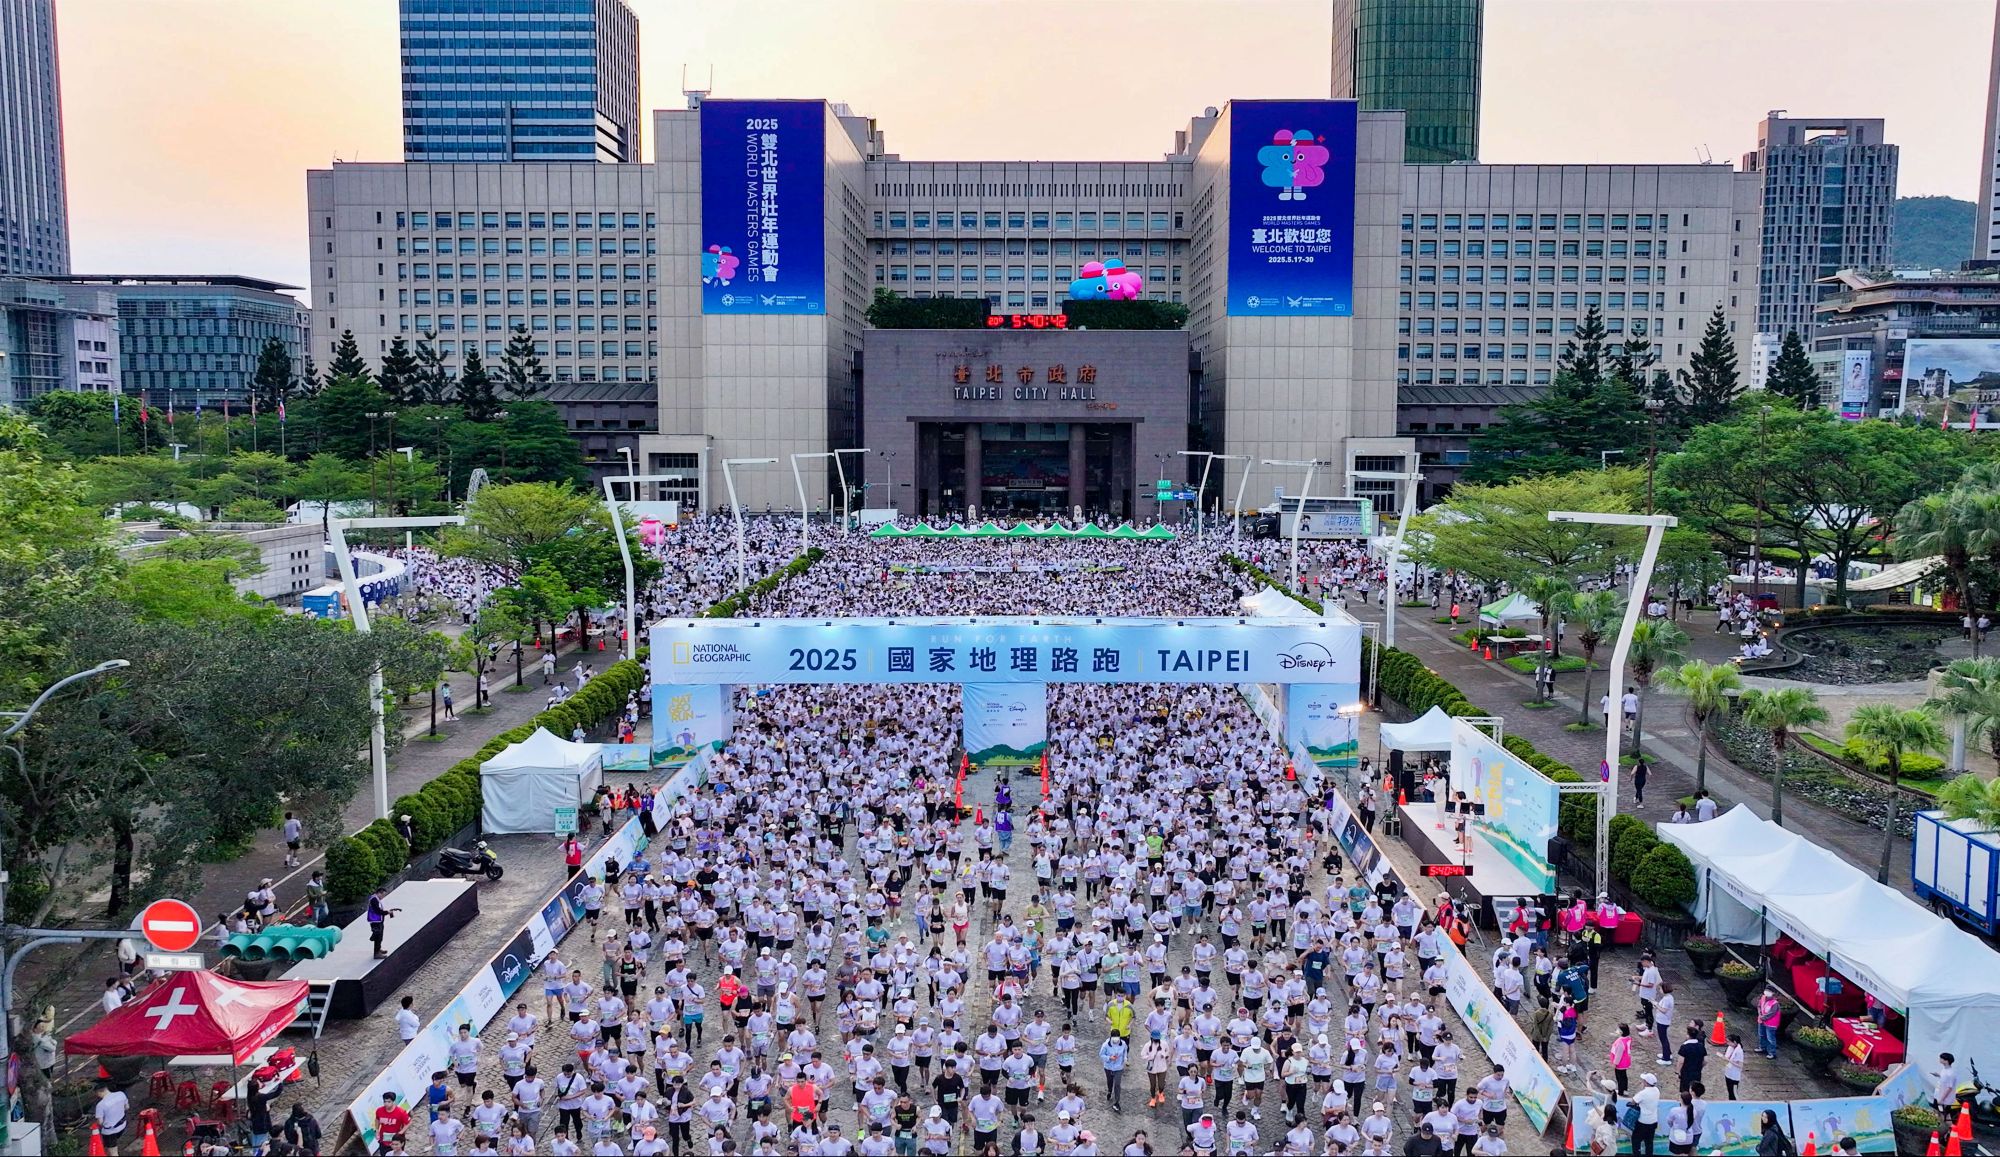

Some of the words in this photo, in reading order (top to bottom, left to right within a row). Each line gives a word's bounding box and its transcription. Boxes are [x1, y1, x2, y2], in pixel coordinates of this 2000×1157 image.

[746, 118, 779, 131] 2025
[746, 133, 760, 178] WORLD
[746, 181, 760, 238] MASTERS
[760, 133, 779, 283] 雙北世界壯年運動會
[1252, 229, 1331, 244] 臺北歡迎您
[1252, 245, 1293, 254] WELCOME
[1295, 245, 1305, 254] TO
[1306, 245, 1332, 254] TAIPEI
[746, 240, 760, 283] GAMES
[1012, 314, 1067, 328] 5:40:42
[954, 364, 1097, 384] 臺北市政府
[954, 387, 1003, 400] TAIPEI
[1014, 387, 1048, 400] CITY
[1060, 387, 1096, 400] HALL
[693, 643, 739, 653] NATIONAL
[692, 653, 751, 663] GEOGRAPHIC
[788, 648, 857, 671] 2025
[887, 646, 1120, 673] 國家地理路跑
[1157, 649, 1249, 672] TAIPEI
[1429, 865, 1465, 876] 5:40:44
